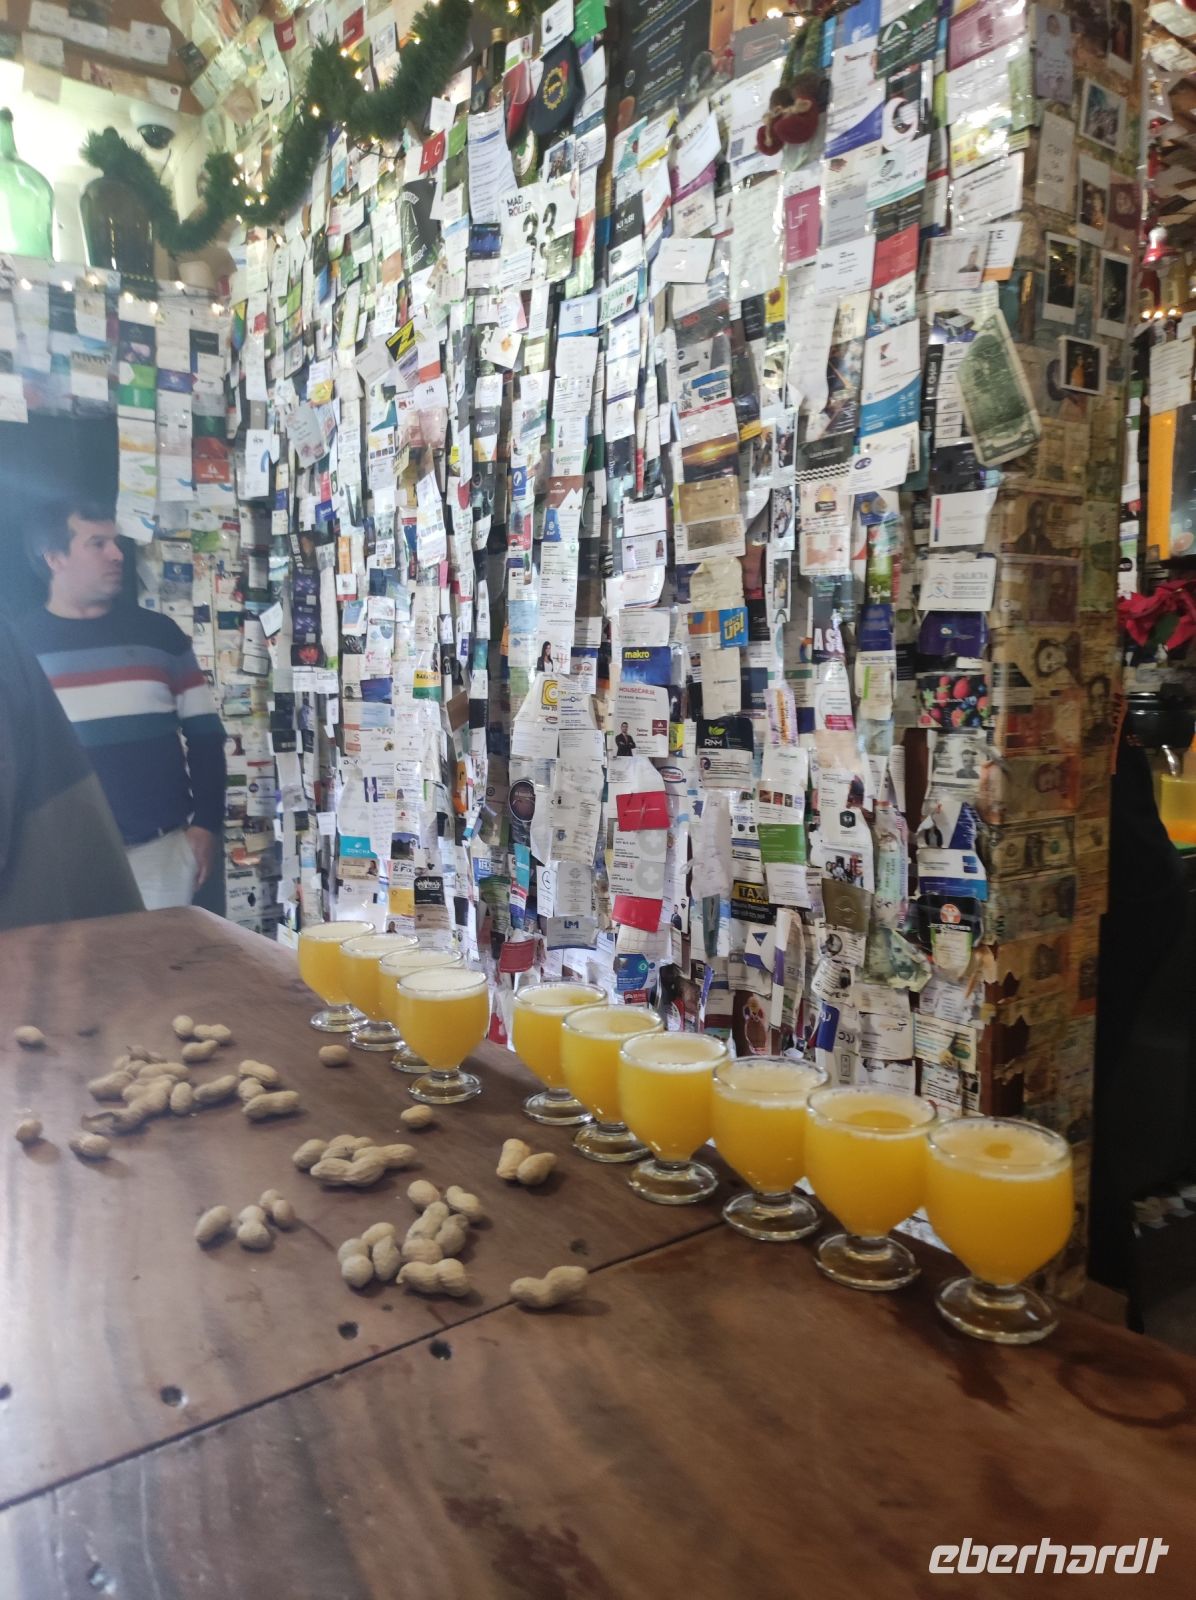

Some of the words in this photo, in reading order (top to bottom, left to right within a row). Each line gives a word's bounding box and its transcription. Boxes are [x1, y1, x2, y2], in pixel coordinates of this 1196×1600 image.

[507, 195, 523, 208] MAD
[624, 650, 650, 659] makro
[704, 738, 722, 747] RNM
